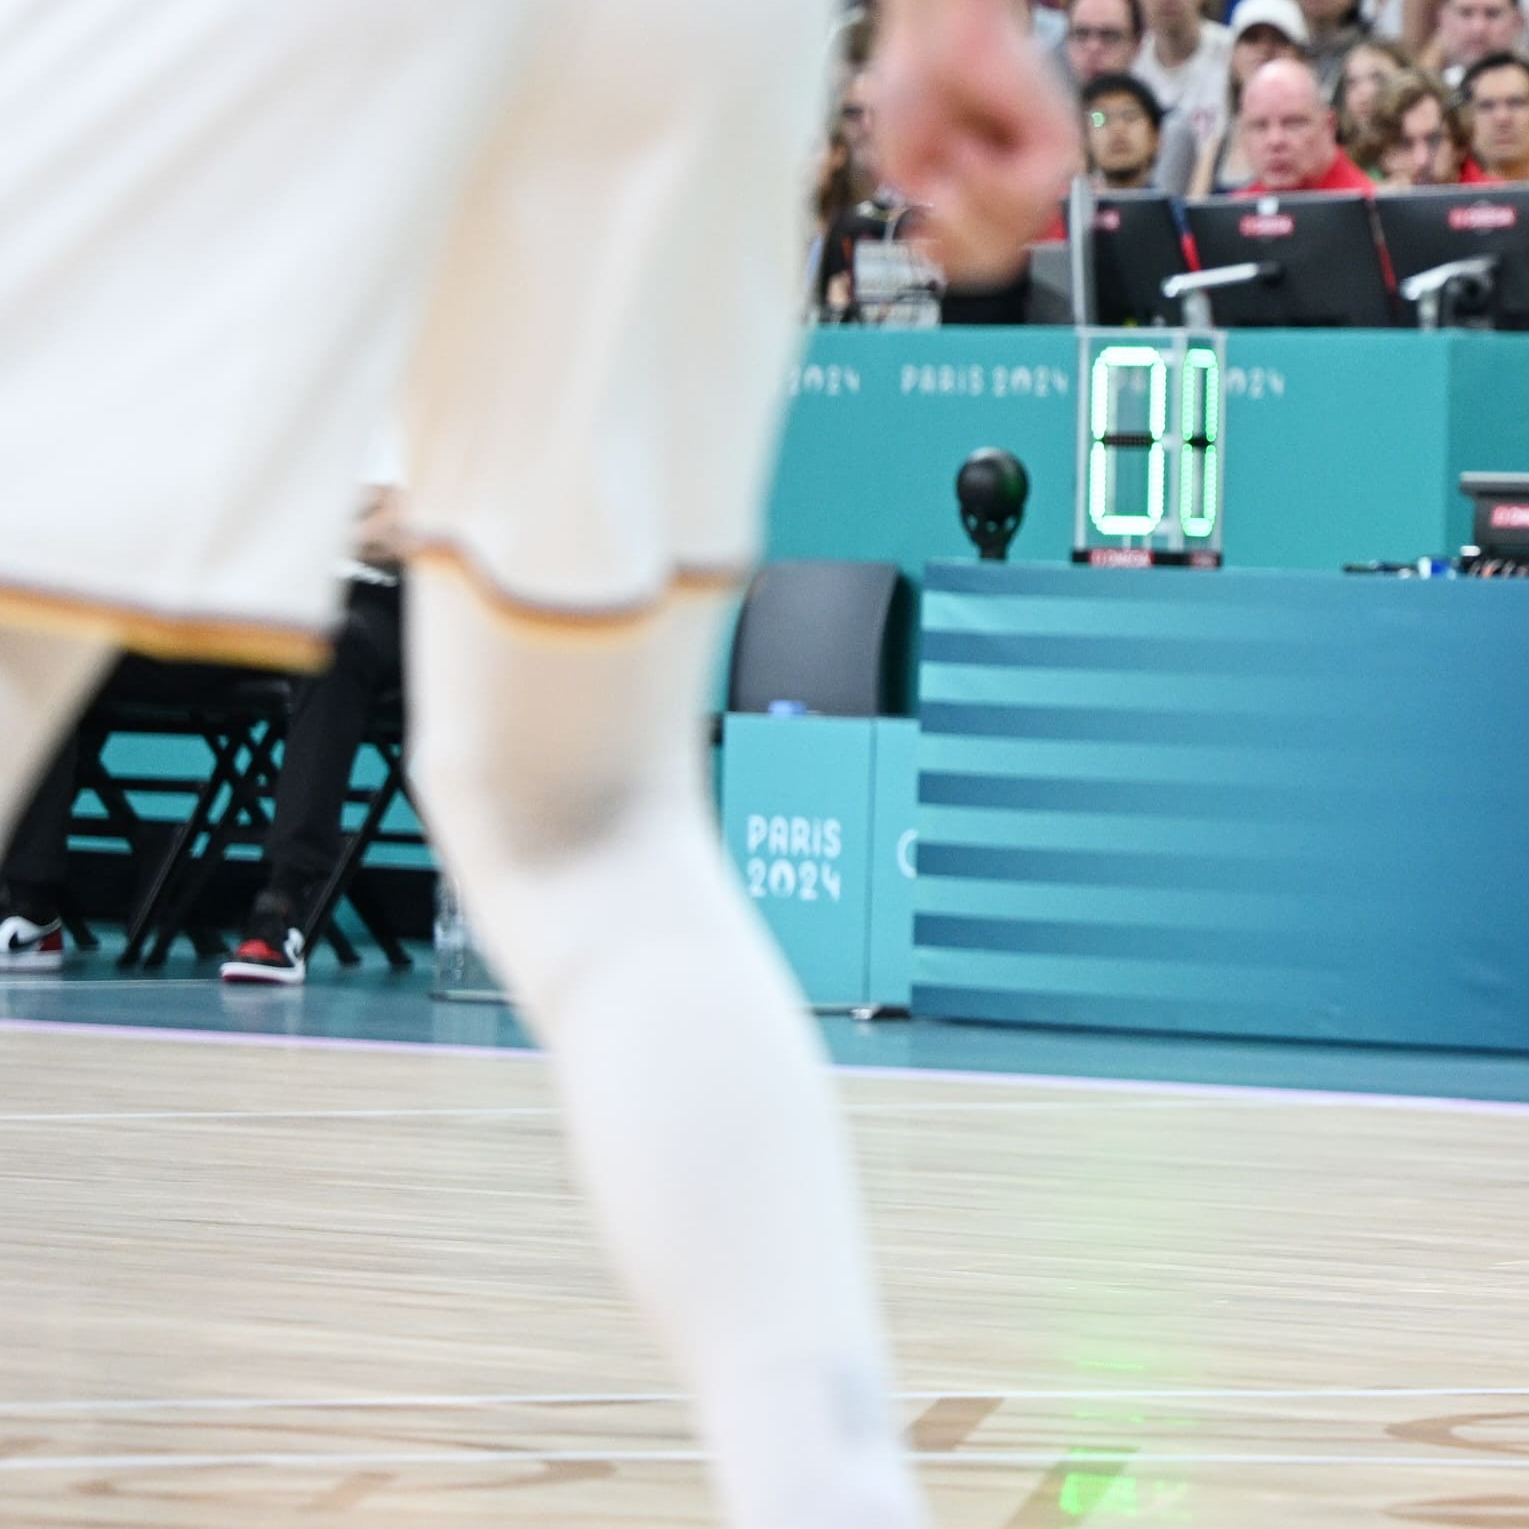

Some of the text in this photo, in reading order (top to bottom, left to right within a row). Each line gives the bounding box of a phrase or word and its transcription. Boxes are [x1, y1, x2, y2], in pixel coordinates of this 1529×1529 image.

[788, 365, 861, 397] 024
[1225, 366, 1286, 399] 024
[747, 857, 842, 902] 2024
